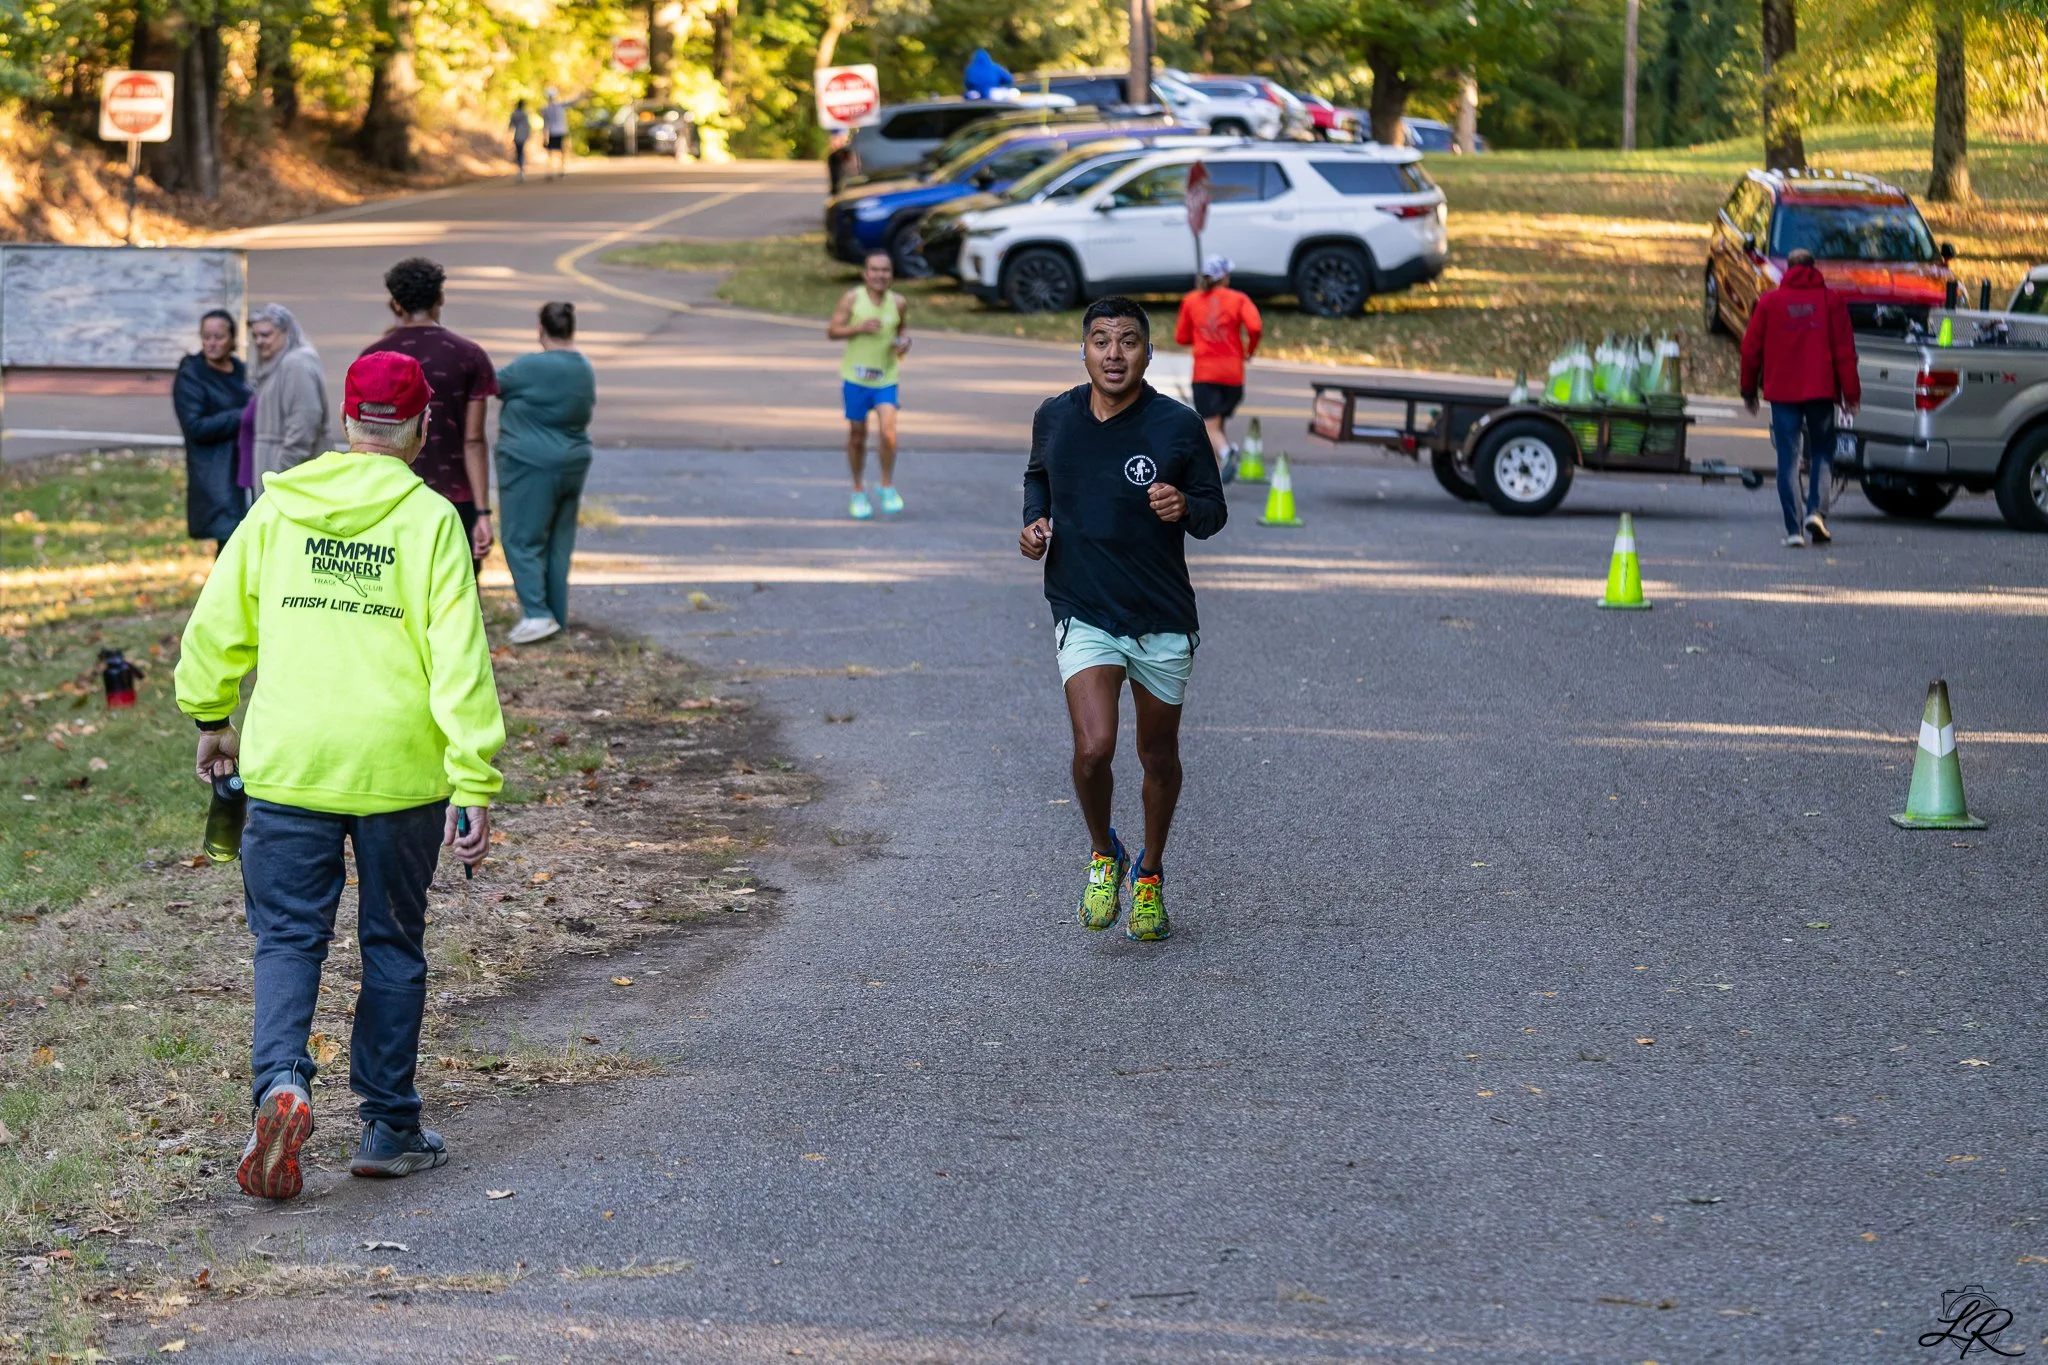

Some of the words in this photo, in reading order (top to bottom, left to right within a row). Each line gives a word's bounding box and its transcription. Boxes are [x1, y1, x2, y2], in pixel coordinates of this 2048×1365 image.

[305, 537, 395, 565] MEMPHIS
[312, 556, 382, 577] RUNNERS
[314, 578, 337, 587] TRACK
[363, 583, 383, 592] CLUB
[281, 596, 328, 608] FINISH
[330, 598, 360, 613] LINE
[362, 603, 405, 619] CREW
